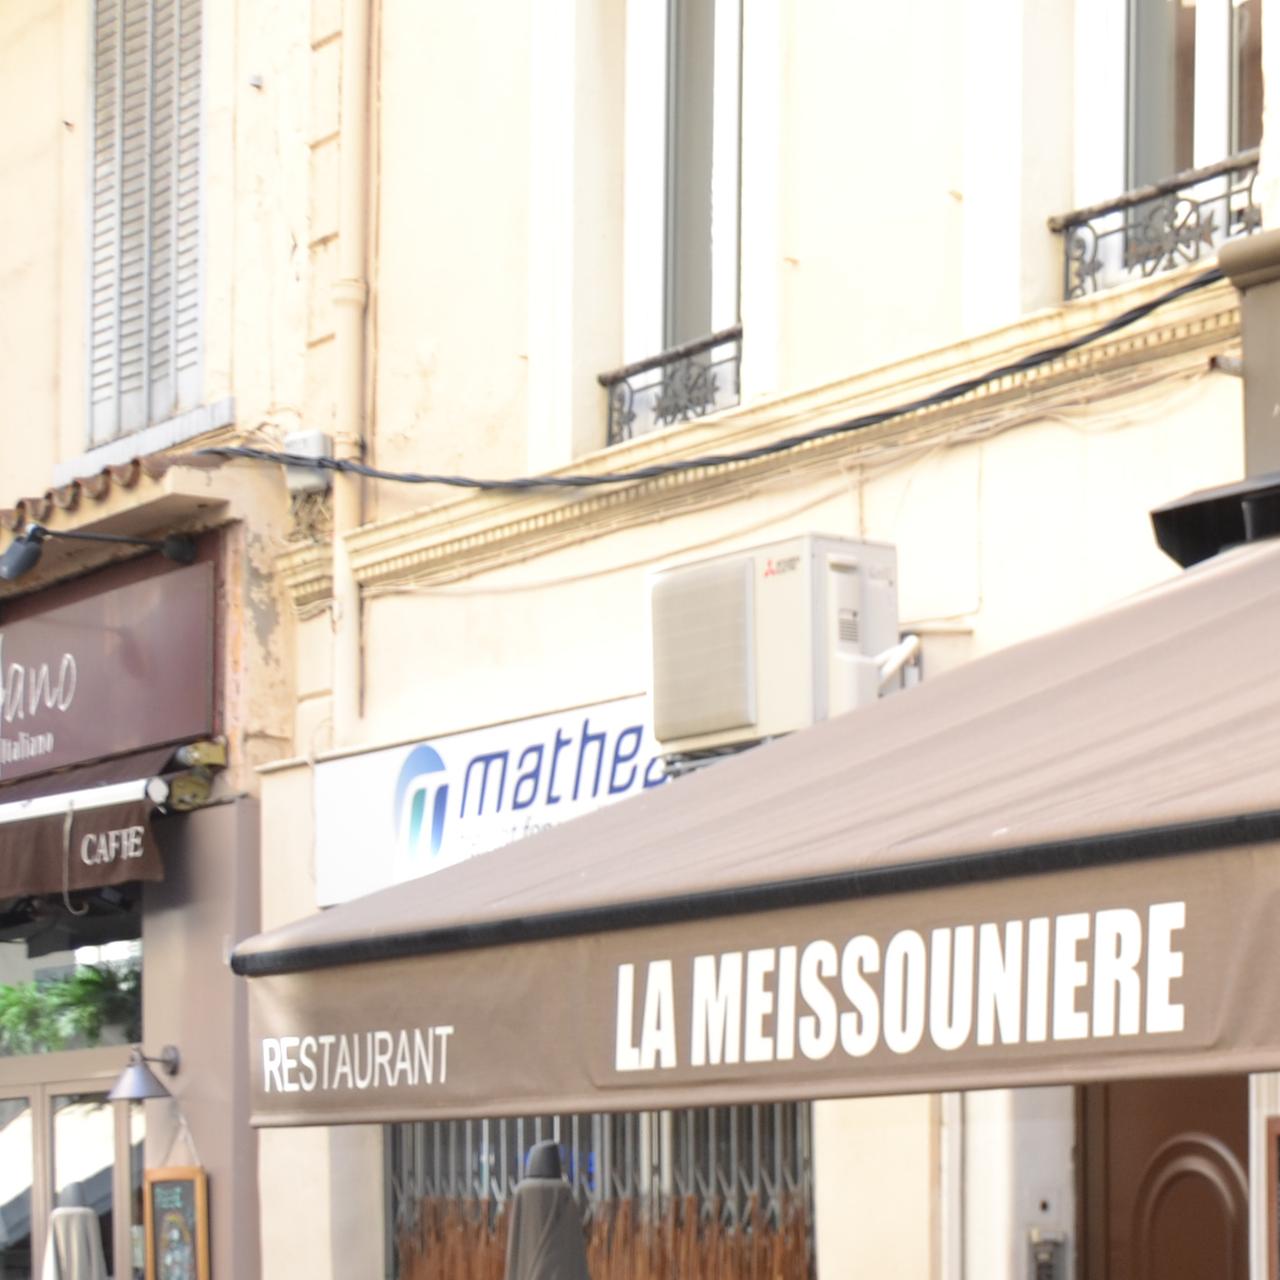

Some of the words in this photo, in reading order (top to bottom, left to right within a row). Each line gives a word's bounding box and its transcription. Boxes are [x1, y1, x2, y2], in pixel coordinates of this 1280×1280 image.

[0, 633, 77, 722] ano
[615, 960, 677, 1072] LA
[690, 901, 1187, 1067] MEISSOUNIERE
[261, 1025, 455, 1094] RESTAURANT
